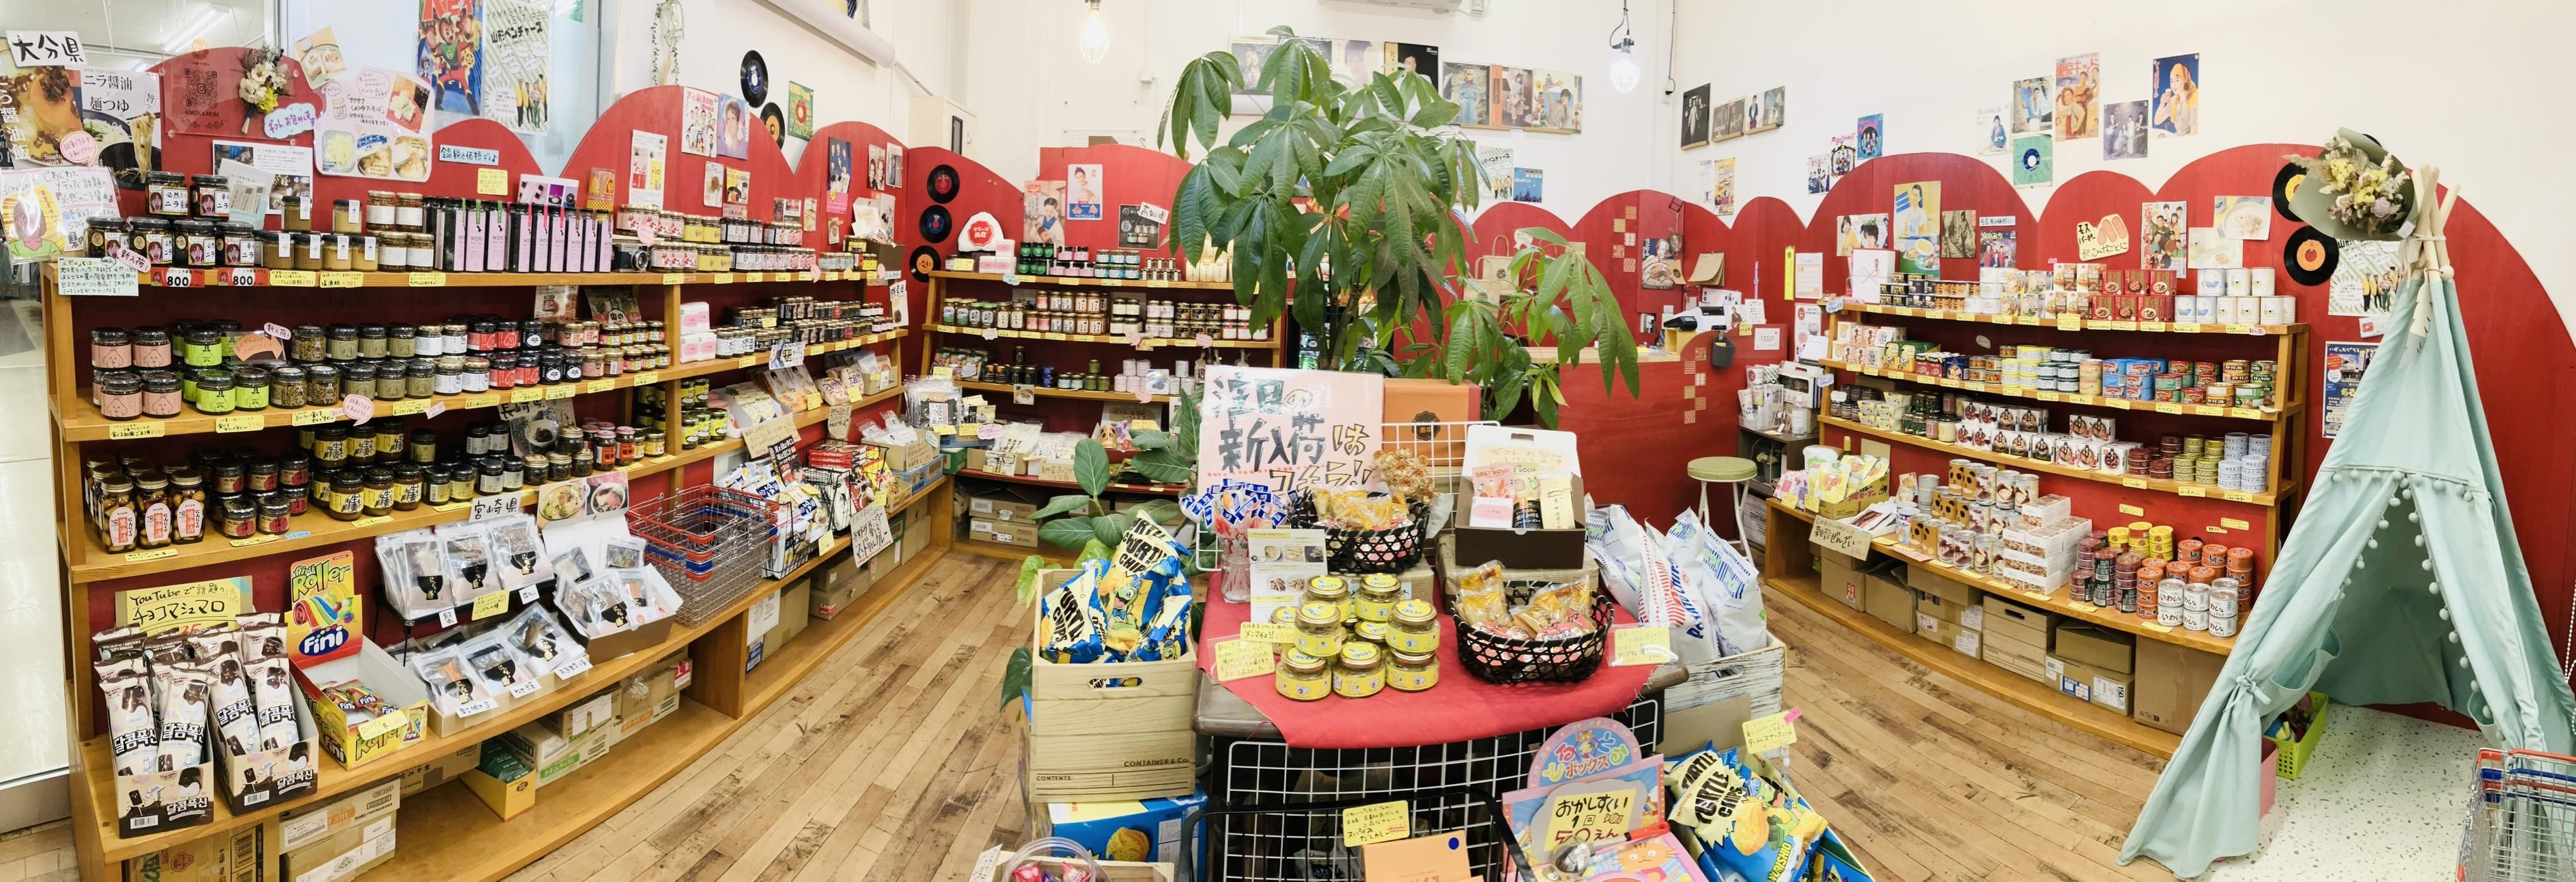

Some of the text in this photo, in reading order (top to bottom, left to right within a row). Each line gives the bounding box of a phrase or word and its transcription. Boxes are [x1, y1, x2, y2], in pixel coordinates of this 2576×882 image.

[13, 34, 84, 62] 大分県
[84, 75, 132, 90] ニラ醤油
[90, 97, 130, 111] 麺つゆ
[2079, 224, 2090, 234] モス
[168, 277, 189, 286] 800
[233, 276, 253, 285] 800
[1475, 470, 1491, 478] BEST
[475, 498, 518, 519] 宮崎県
[292, 559, 351, 602] Roller
[133, 600, 225, 625] チョコマシュマロ
[1052, 606, 1068, 642] CHIPS
[304, 626, 344, 654] Fini
[360, 695, 377, 705] Fini
[1124, 759, 1169, 767] CONTAINER
[1557, 795, 1628, 818] おかしすくい
[1695, 770, 1729, 825] TURTLE
[1718, 785, 1743, 818] CHIPS
